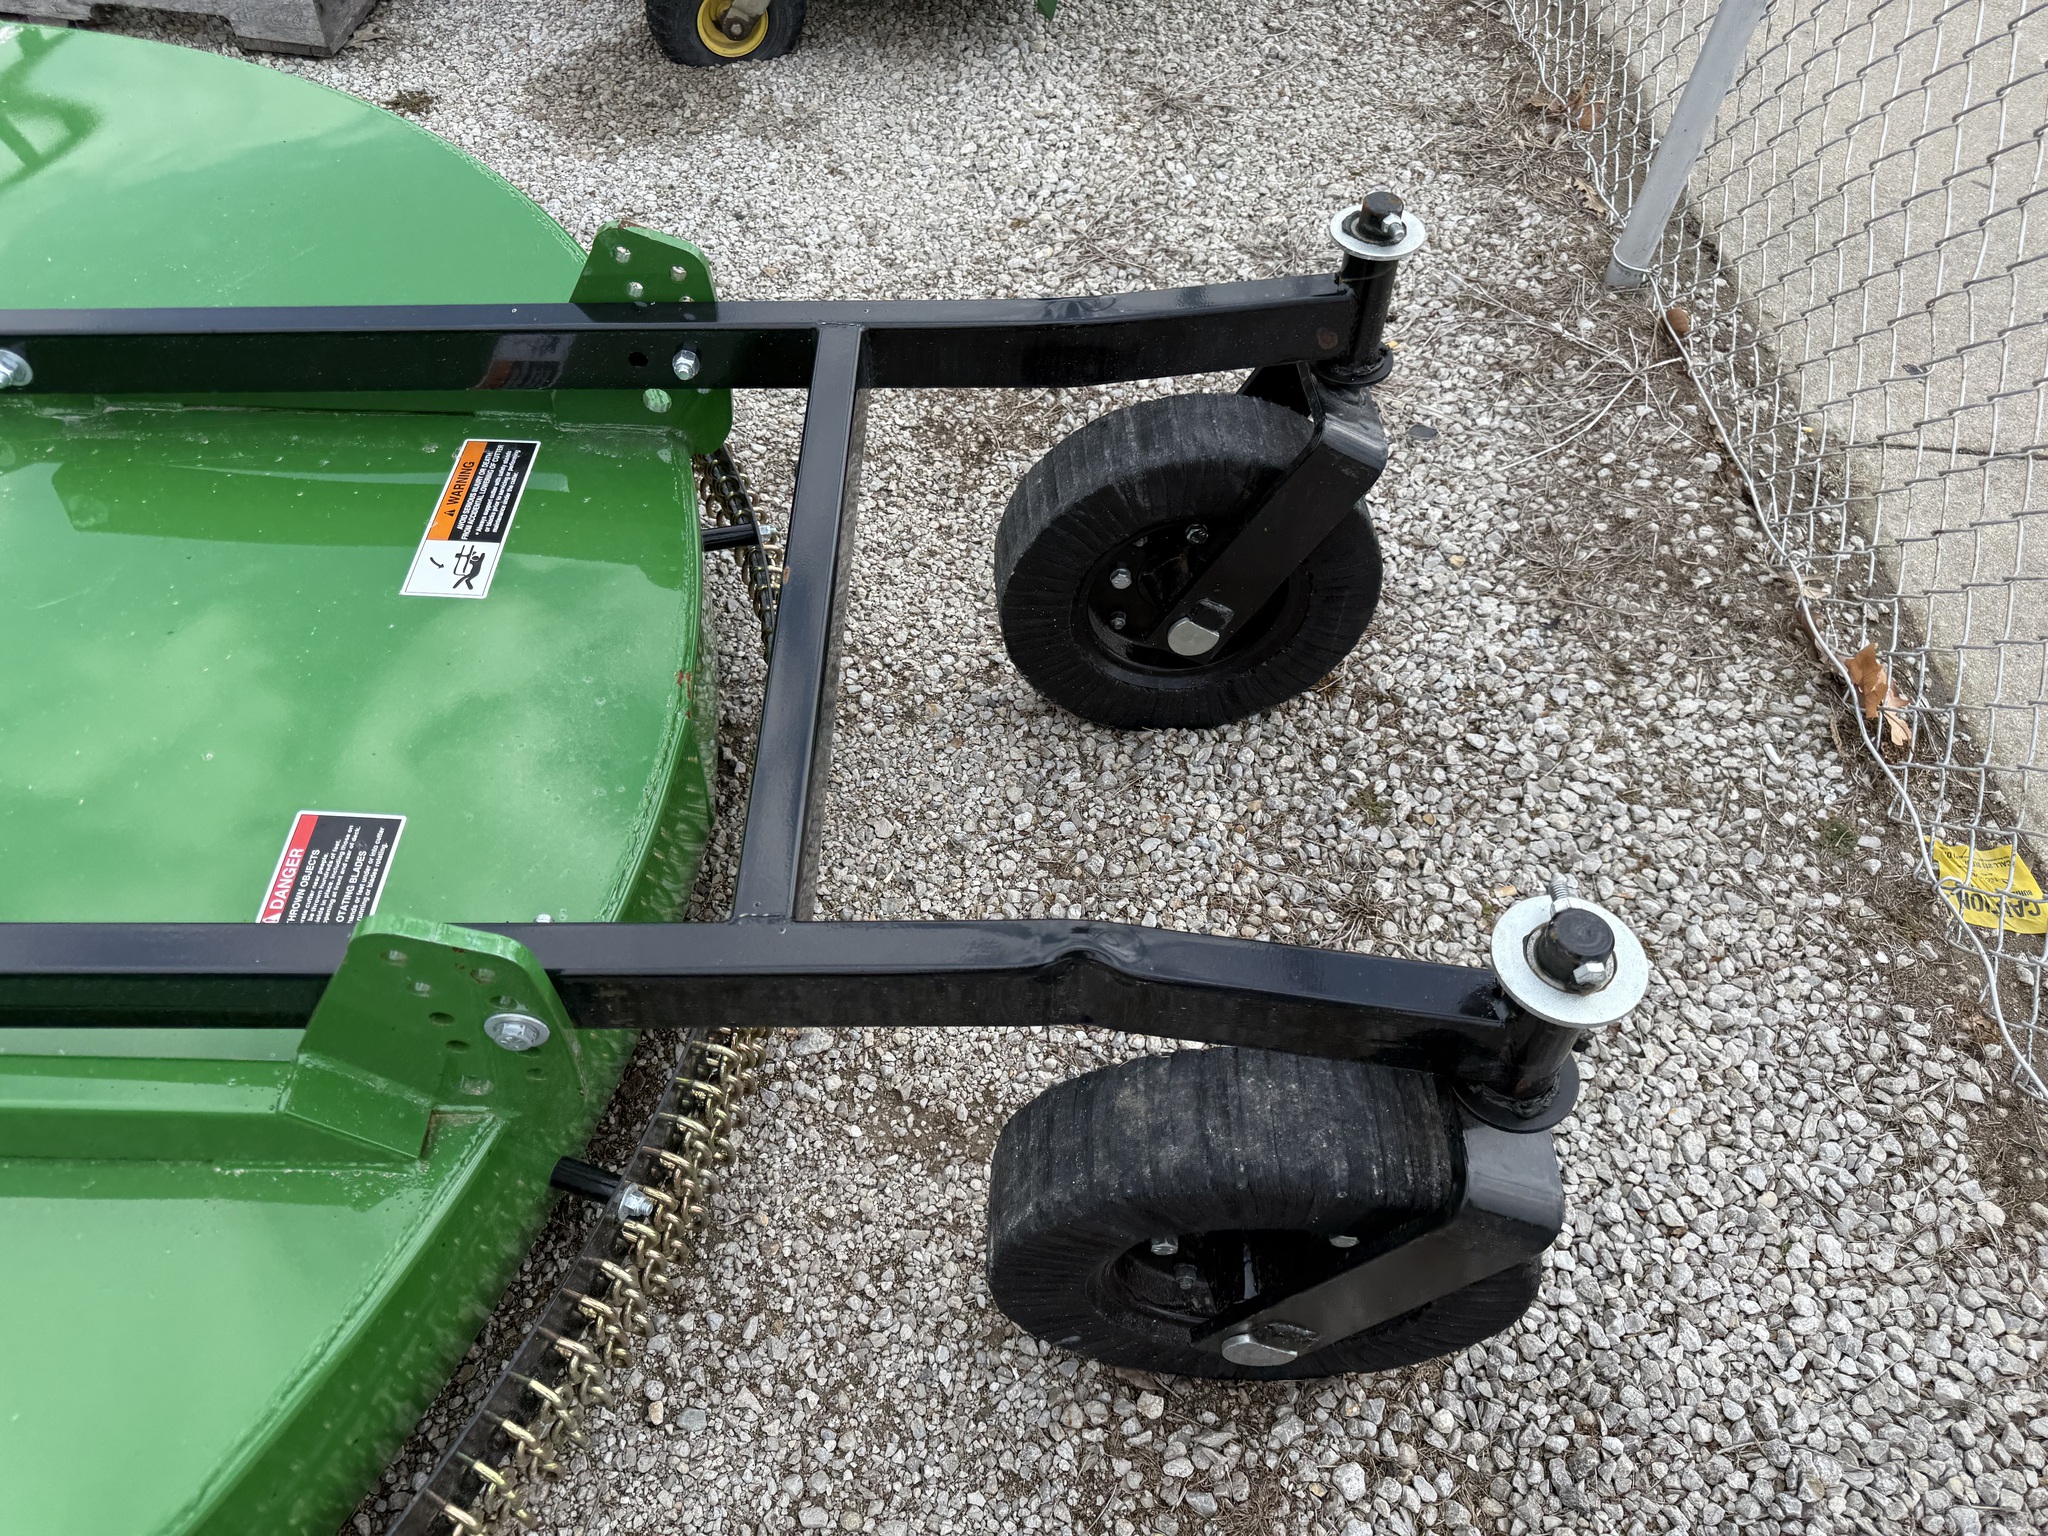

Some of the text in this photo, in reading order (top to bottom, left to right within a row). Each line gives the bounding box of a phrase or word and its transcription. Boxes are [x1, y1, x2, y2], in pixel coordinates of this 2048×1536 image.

[447, 461, 474, 504] WARNING
[456, 514, 467, 529] AVOID
[462, 492, 476, 514] SERIOUS
[478, 467, 486, 475] OR
[460, 524, 472, 539] FROM
[467, 494, 484, 524] ACCIDENTAL
[491, 444, 504, 462] CUTTER
[269, 848, 304, 909] DANGER
[286, 849, 320, 923] HROWN OBJECTS
[335, 850, 366, 922] OTATING BLADES
[361, 865, 371, 882] under
[364, 888, 371, 896] or
[300, 909, 308, 923] rate
